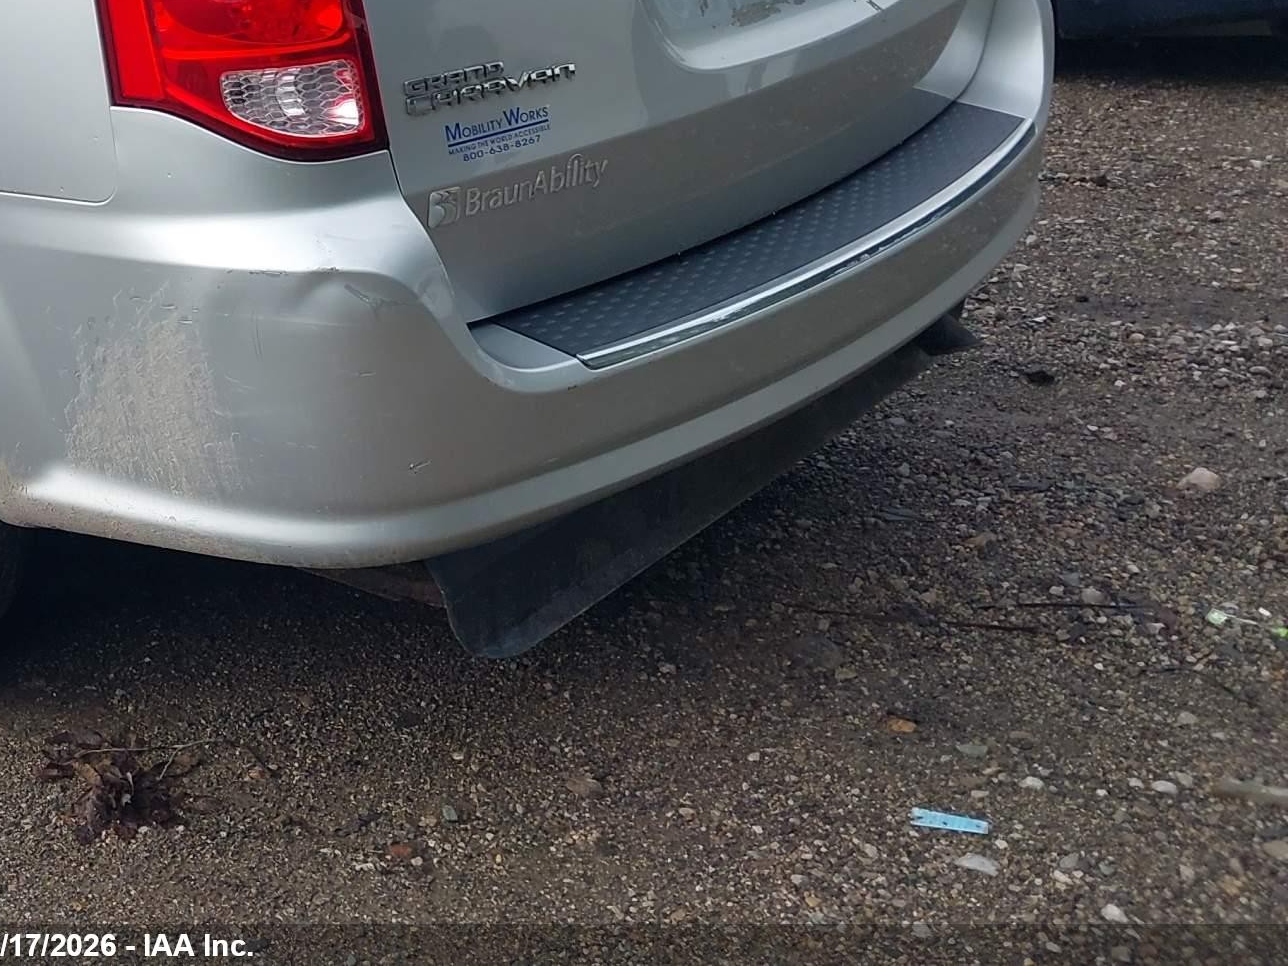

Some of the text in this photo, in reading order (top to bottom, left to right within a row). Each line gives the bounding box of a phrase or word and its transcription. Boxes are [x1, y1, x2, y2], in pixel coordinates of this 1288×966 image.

[463, 135, 541, 162] 800-638-8267
[478, 141, 489, 149] THE
[489, 135, 512, 145] WORLD
[465, 153, 609, 217] BraunAbility
